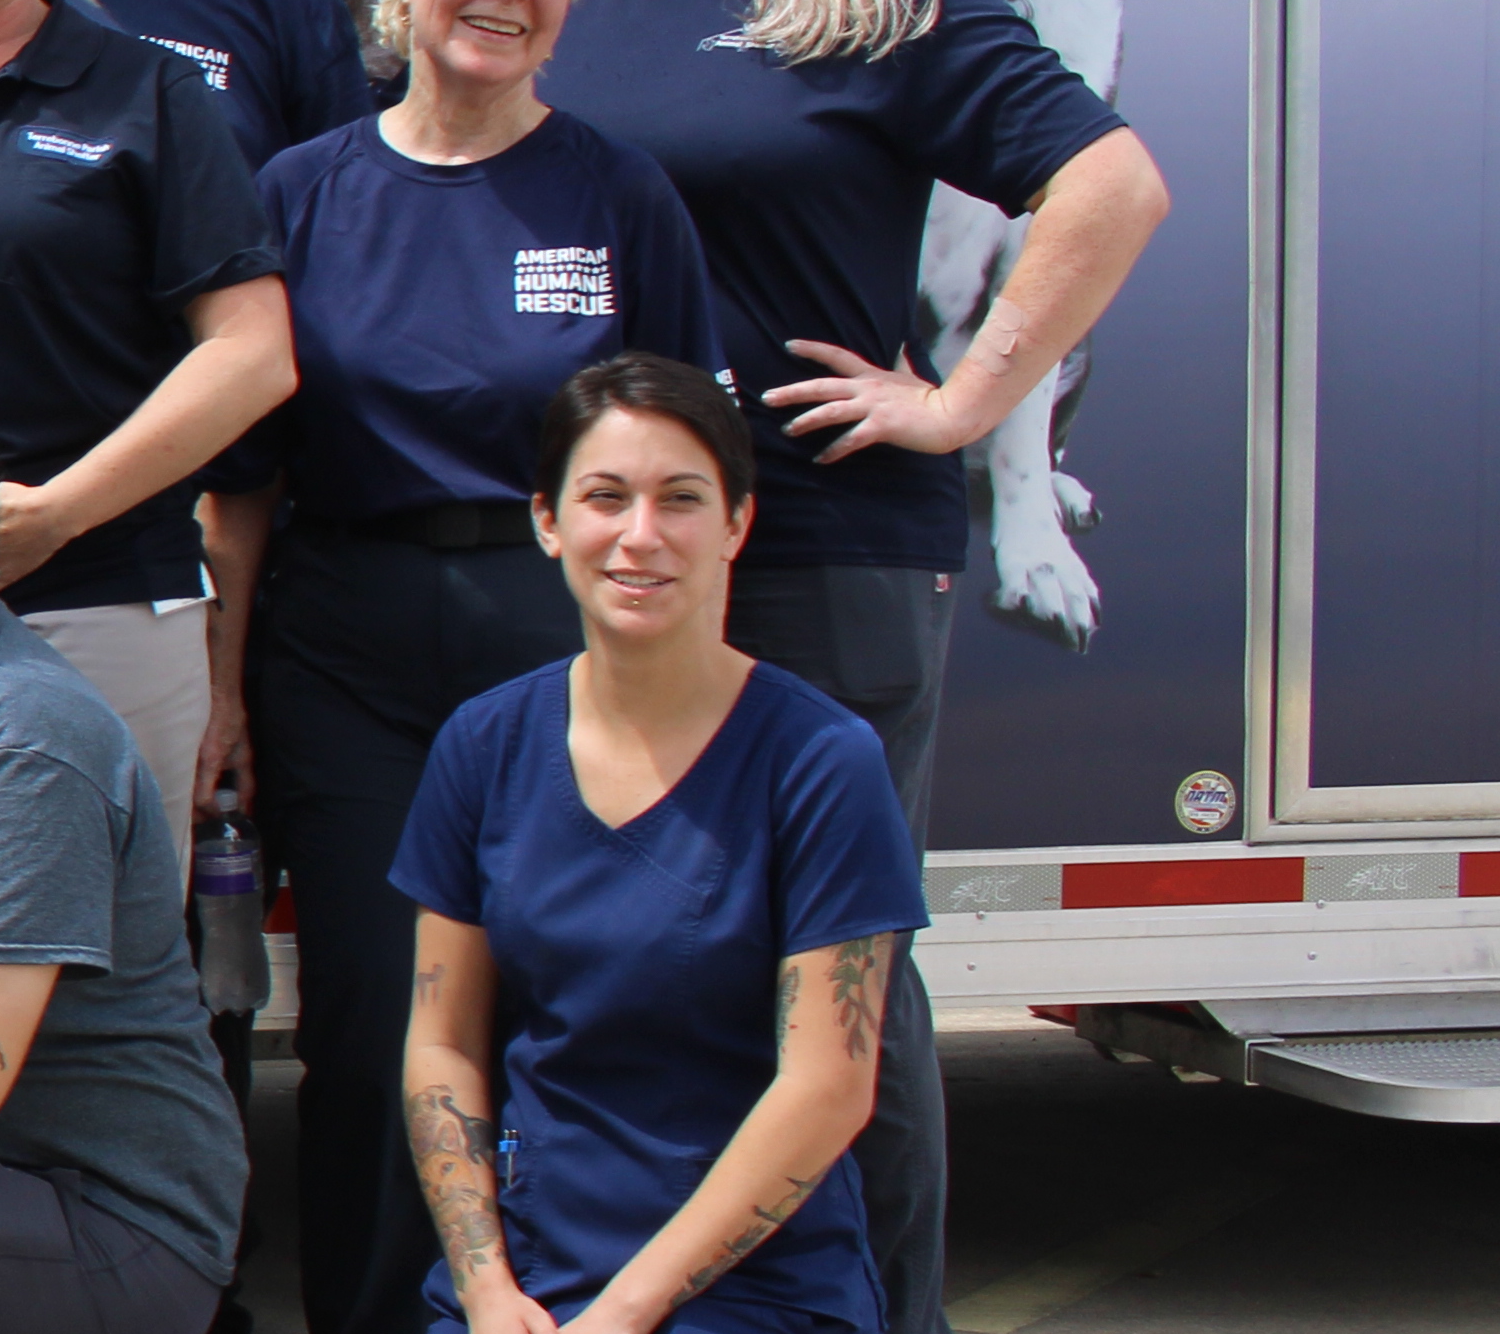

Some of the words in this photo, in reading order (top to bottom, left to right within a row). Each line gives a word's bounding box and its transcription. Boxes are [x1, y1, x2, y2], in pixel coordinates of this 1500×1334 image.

[139, 34, 230, 66] ERICAN
[513, 247, 609, 265] AMERICAN
[514, 272, 613, 293] HUMANE
[515, 292, 617, 316] RESCUE
